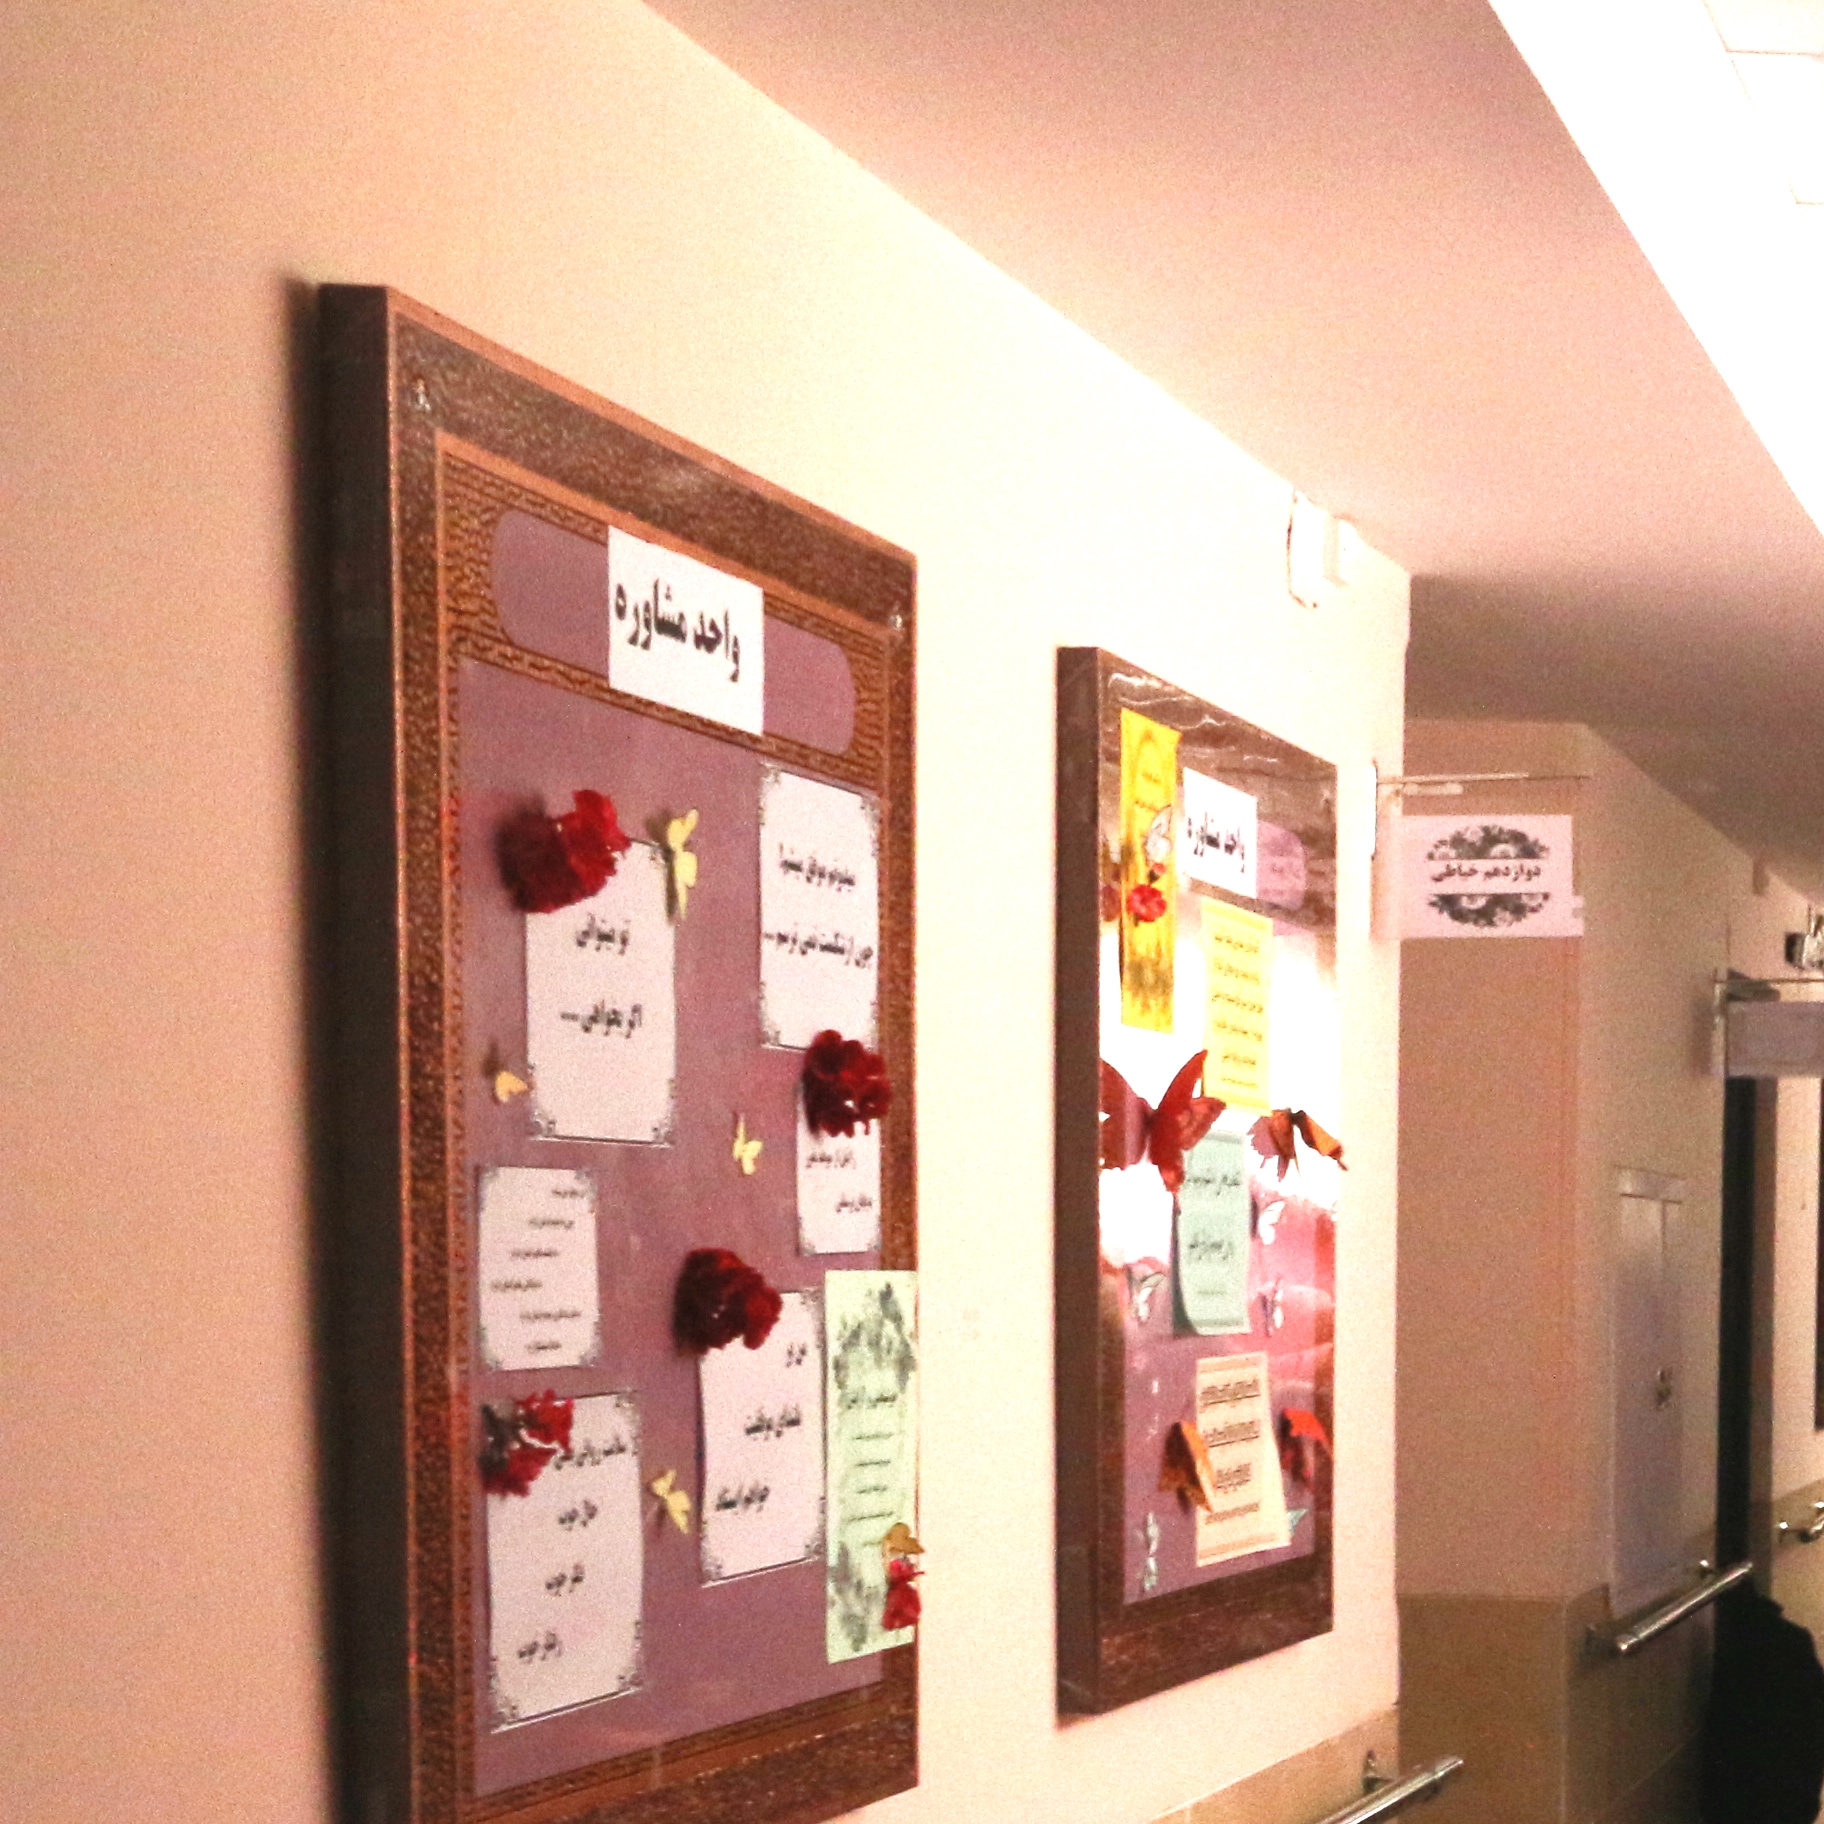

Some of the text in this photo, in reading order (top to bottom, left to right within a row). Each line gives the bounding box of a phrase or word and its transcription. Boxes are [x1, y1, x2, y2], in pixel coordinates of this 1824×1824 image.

[615, 577, 740, 683] واحد مشاوره
[1187, 811, 1246, 874] واحد مشاوره
[1483, 864, 1542, 882] دوازدهم
